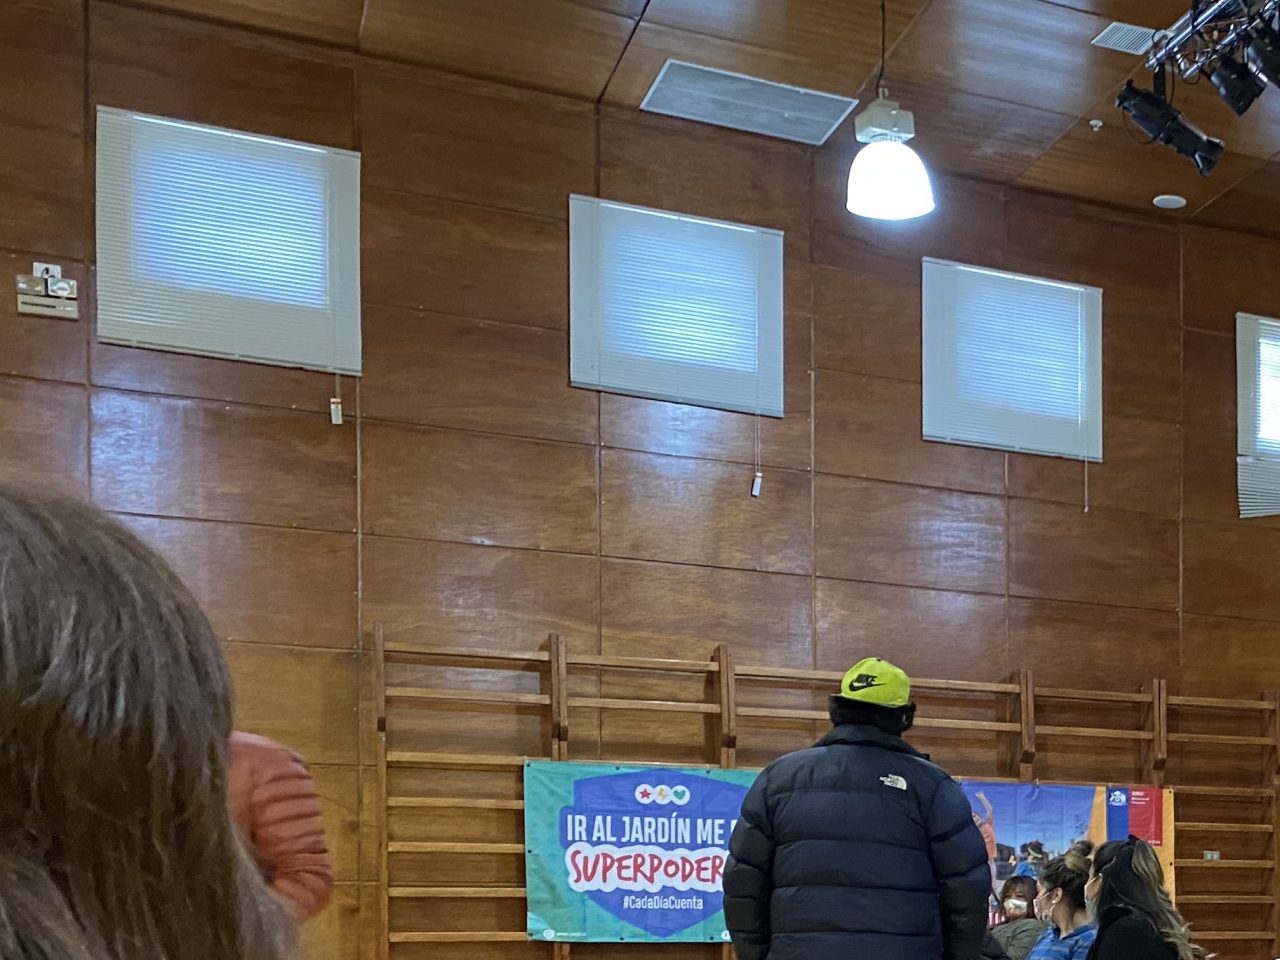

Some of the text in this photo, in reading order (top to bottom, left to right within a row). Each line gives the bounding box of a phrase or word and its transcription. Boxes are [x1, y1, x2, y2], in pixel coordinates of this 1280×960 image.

[566, 814, 587, 841] IR
[592, 815, 617, 842] AL
[621, 812, 691, 844] JARDÍN
[696, 818, 725, 845] ME
[623, 895, 704, 910] #CadaDíaCuenta
